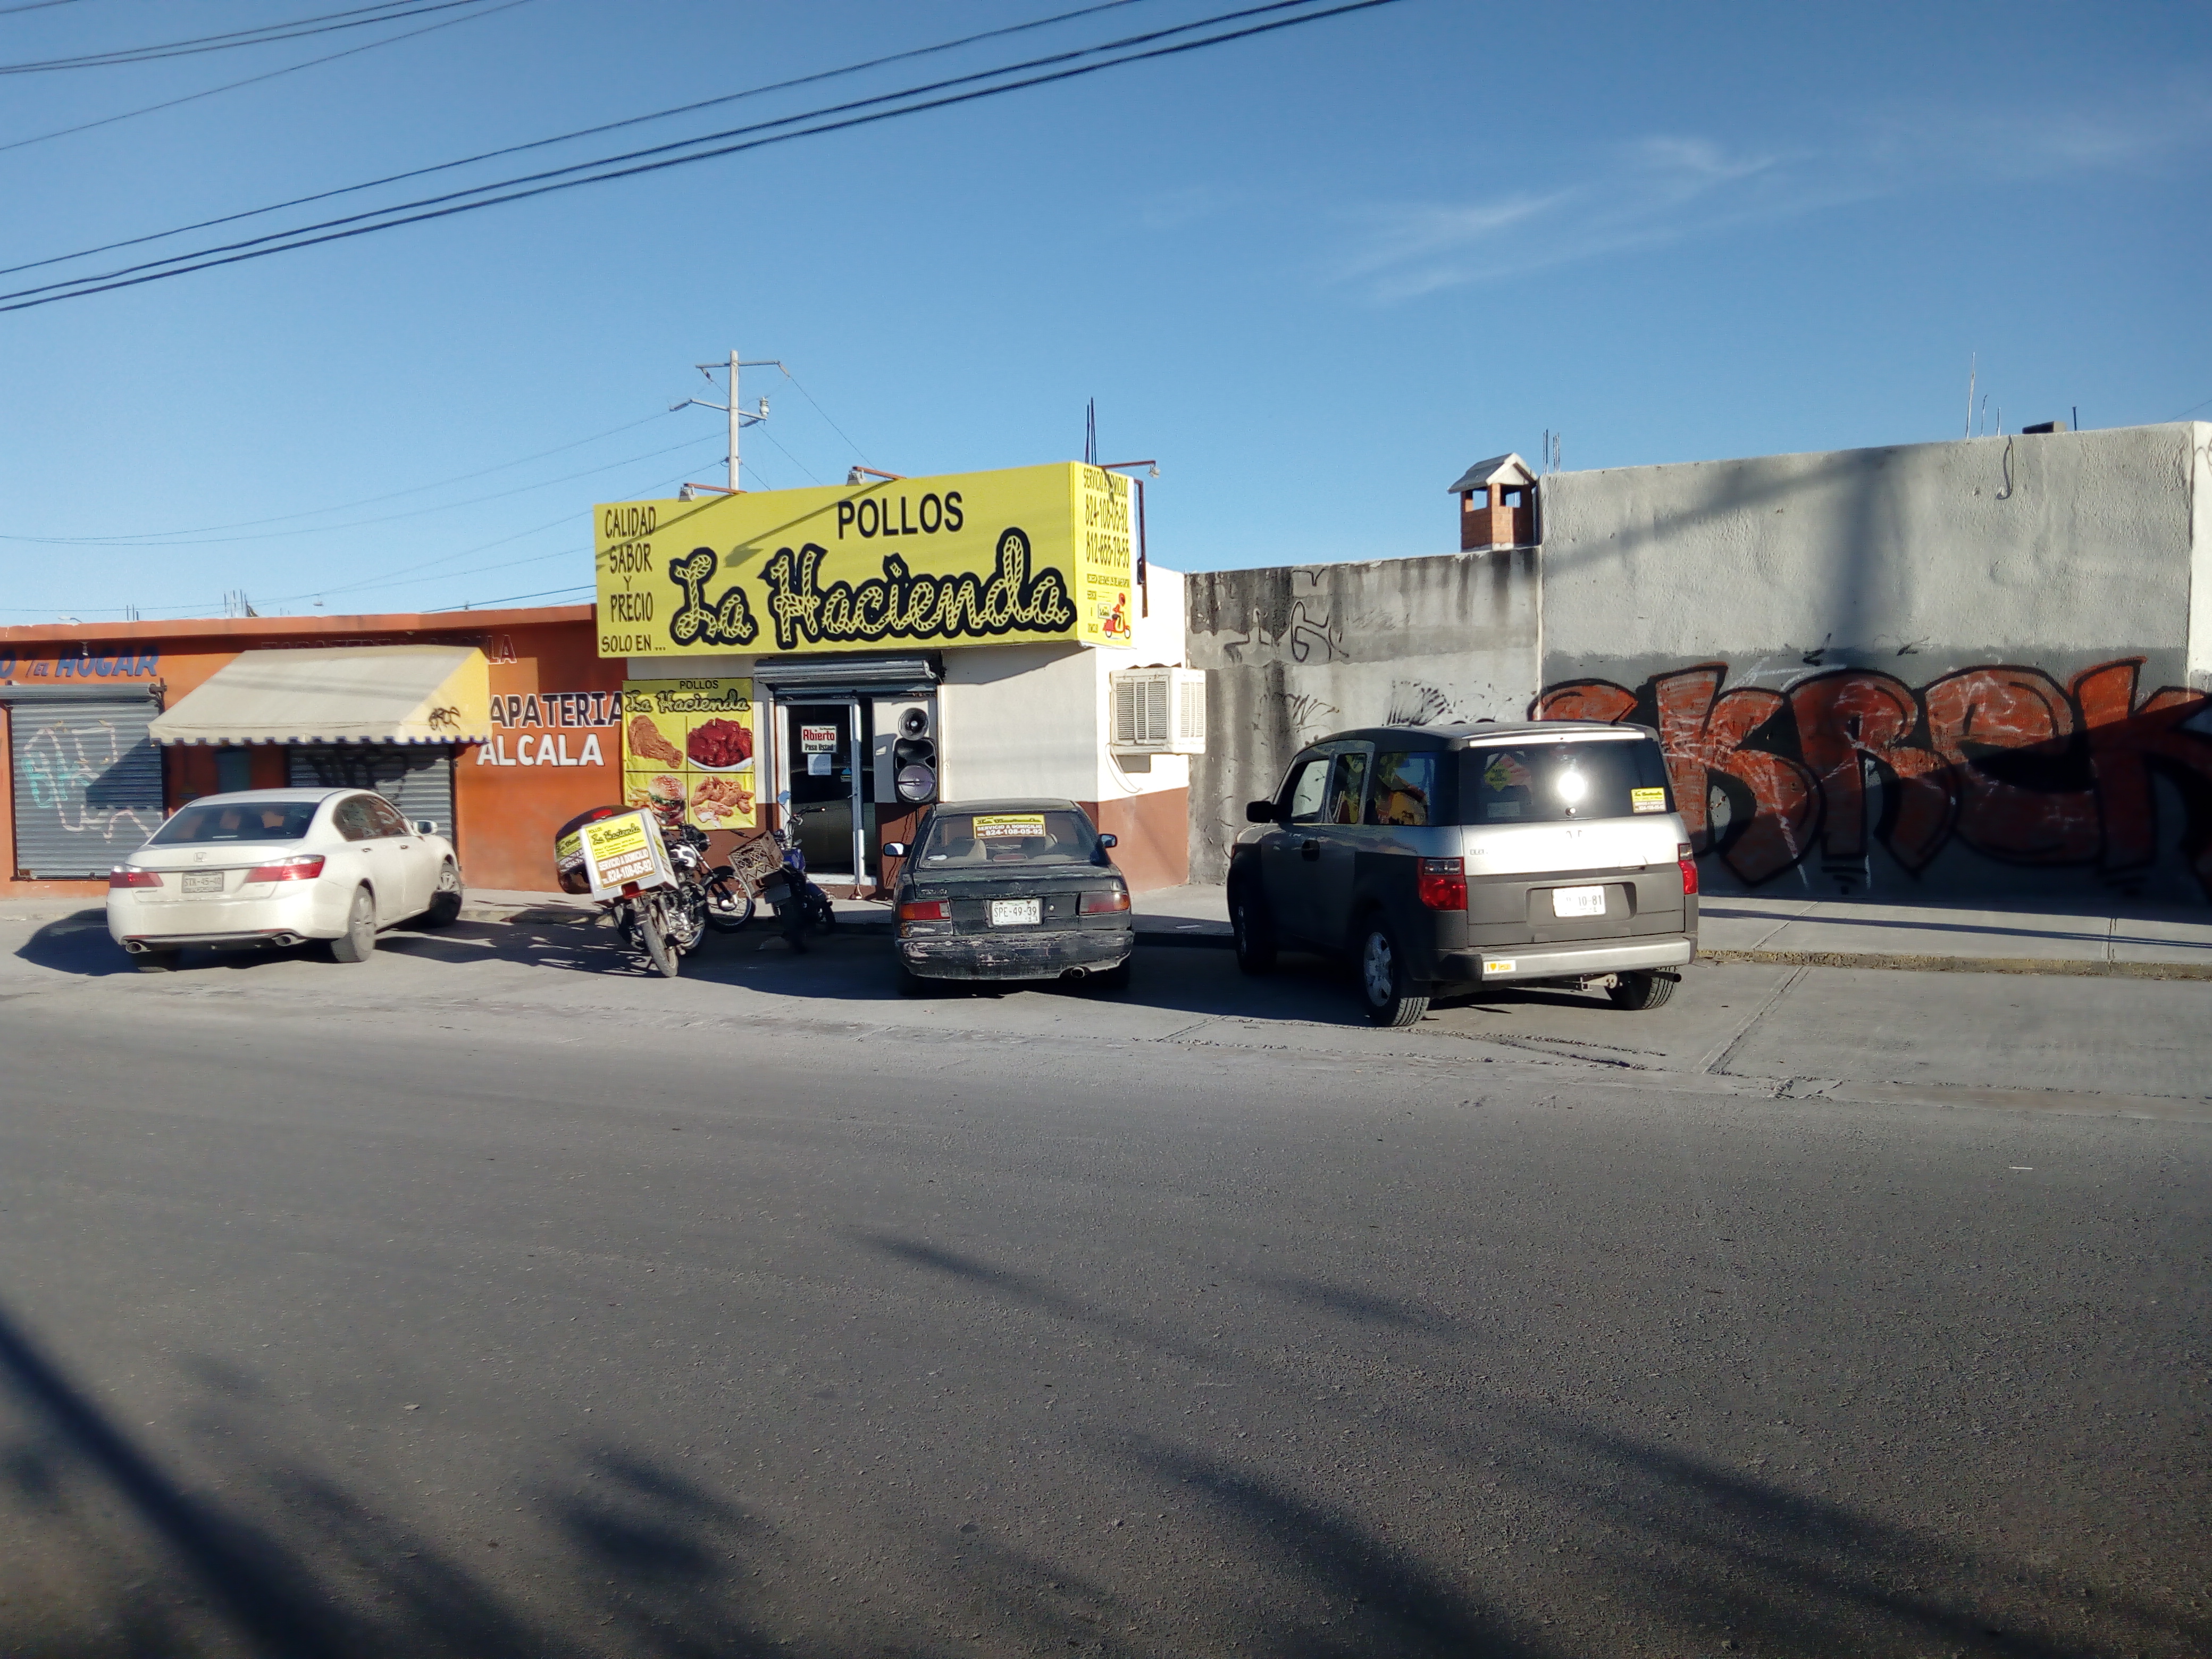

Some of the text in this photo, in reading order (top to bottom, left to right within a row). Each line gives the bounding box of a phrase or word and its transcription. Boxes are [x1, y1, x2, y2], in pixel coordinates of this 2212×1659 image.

[1108, 473, 1128, 499] MICILIO
[605, 506, 656, 539] CALIDAD
[837, 491, 963, 540] POLLOS
[609, 542, 652, 574] SABOR
[623, 575, 632, 591] Y
[669, 527, 1077, 650] La Hacienda
[610, 592, 653, 623] PRECIO
[601, 635, 633, 652] SOLO
[55, 646, 159, 677] HOGAR
[680, 680, 718, 690] POLLOS
[491, 691, 622, 728] APATERIA
[625, 689, 750, 713] La Hacienda
[476, 733, 605, 767] ALCALA
[599, 855, 621, 870] SERVICIO
[608, 859, 653, 883] 824-108-05-92
[994, 907, 1037, 917] SPE-49-39
